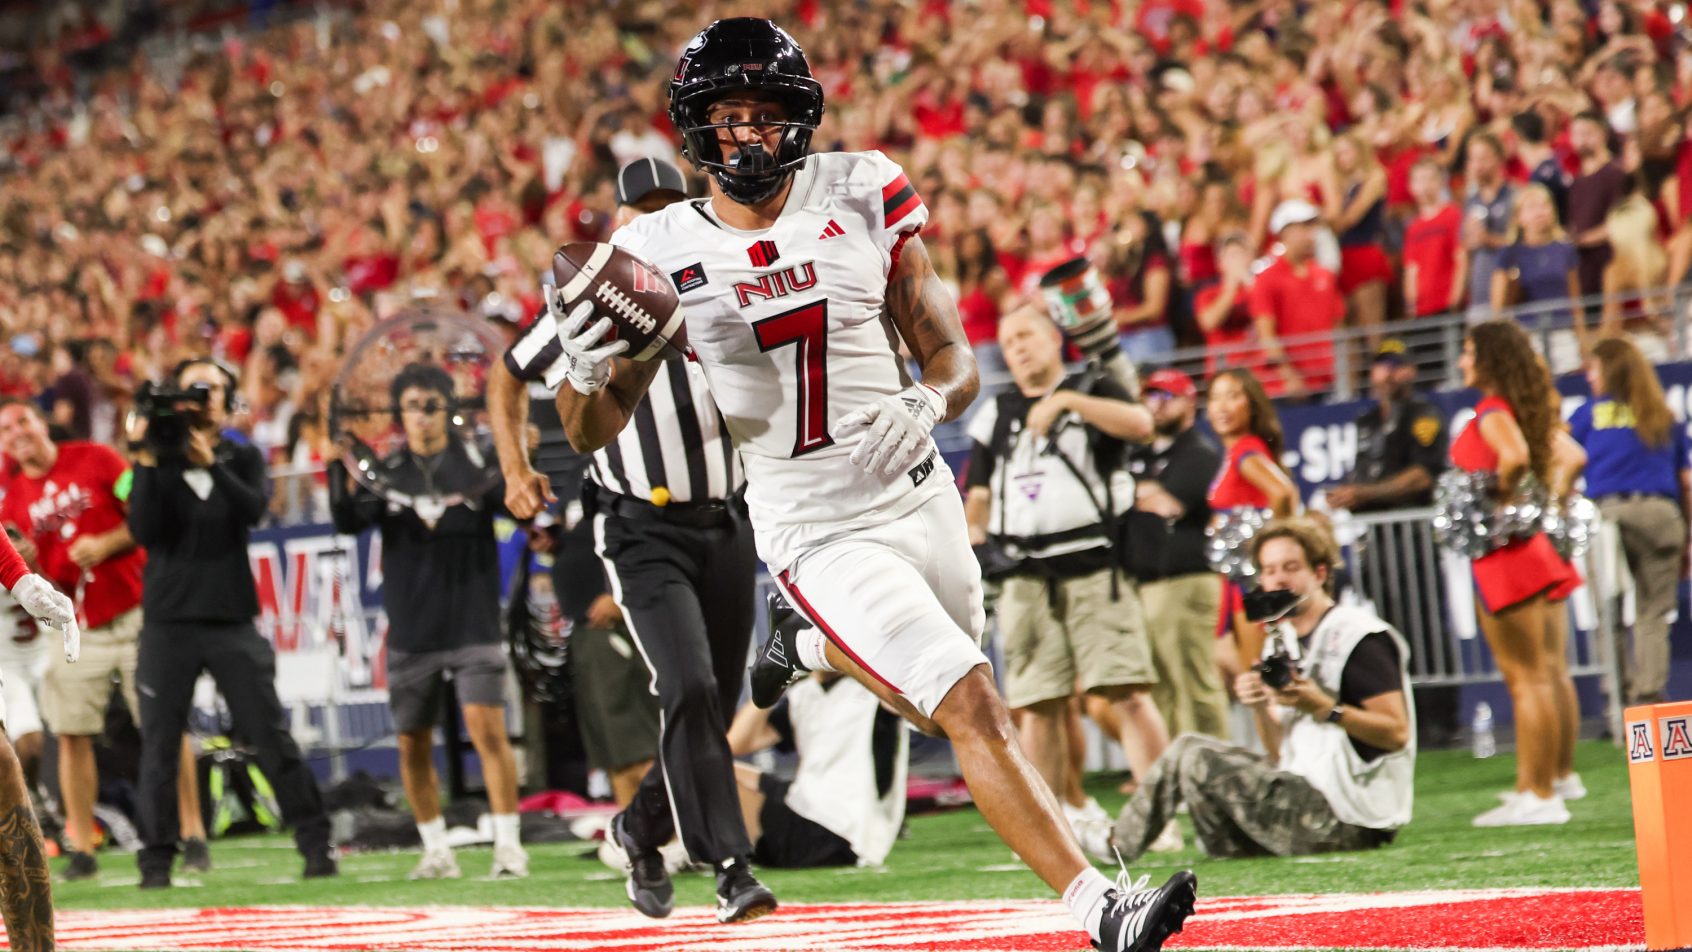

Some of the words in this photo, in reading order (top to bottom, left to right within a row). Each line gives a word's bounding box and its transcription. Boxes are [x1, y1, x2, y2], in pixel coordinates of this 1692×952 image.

[732, 260, 818, 309] NIU
[752, 297, 836, 458] 7
[1631, 723, 1653, 760] A
[1664, 719, 1692, 757] A
